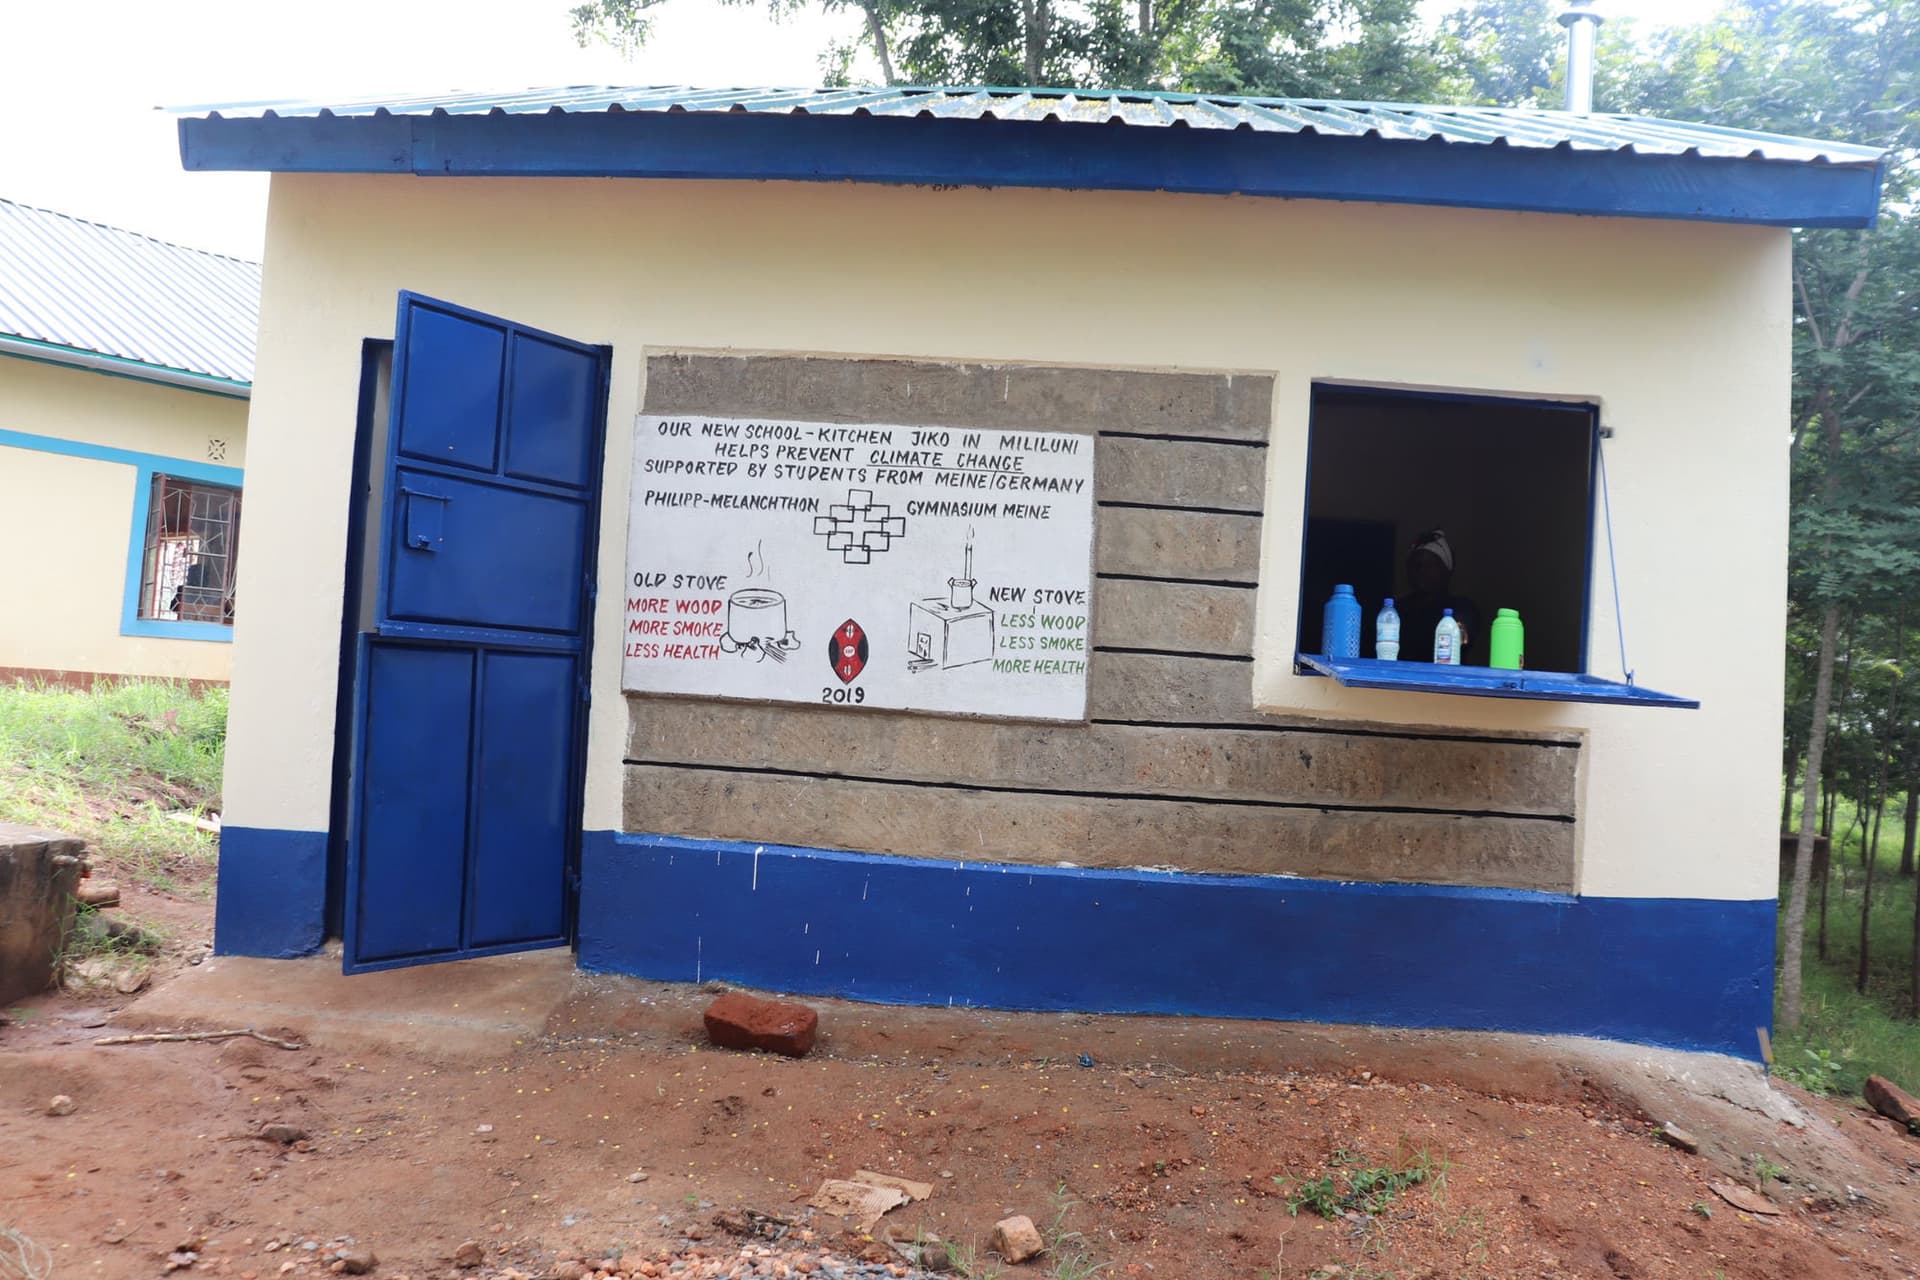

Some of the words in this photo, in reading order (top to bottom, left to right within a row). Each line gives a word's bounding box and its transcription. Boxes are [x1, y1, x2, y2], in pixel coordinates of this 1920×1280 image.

[658, 421, 692, 437] OUR
[701, 423, 740, 438] NEW
[911, 431, 950, 447] JIKO
[962, 434, 981, 449] IN
[999, 435, 1079, 455] MILILUNI
[715, 443, 769, 458] HELPS
[776, 445, 854, 462] PREVENT
[870, 450, 943, 467] CLIMATE
[957, 453, 1024, 472] CHANGE
[644, 459, 738, 476] SUPPORTED
[747, 463, 767, 478] BY
[774, 466, 867, 482] STUDENTS
[875, 469, 923, 485] FROM
[935, 471, 1085, 494] MEINE/GERMANY
[644, 490, 819, 513] PHILIPP-MELANCHTHON
[907, 500, 997, 518] GYMNASIUM
[1003, 504, 1052, 520] MEINE
[633, 572, 667, 588] OLD
[673, 574, 728, 590] STOVE
[990, 586, 1026, 602] NEW
[1033, 589, 1086, 605] STOVE
[627, 598, 670, 613] MORE
[676, 600, 722, 615] WOOD
[629, 619, 670, 636] MORE
[673, 621, 723, 637] SMOKE
[1000, 614, 1036, 629] LESS
[1041, 614, 1086, 630] WOOD
[625, 643, 660, 658] LESS
[663, 644, 720, 660] HEALTH
[1000, 636, 1035, 650] LESS
[1040, 637, 1085, 651] SMOKE
[992, 659, 1031, 673] MORE
[1033, 660, 1086, 675] HEALTH
[822, 686, 865, 705] 2019
